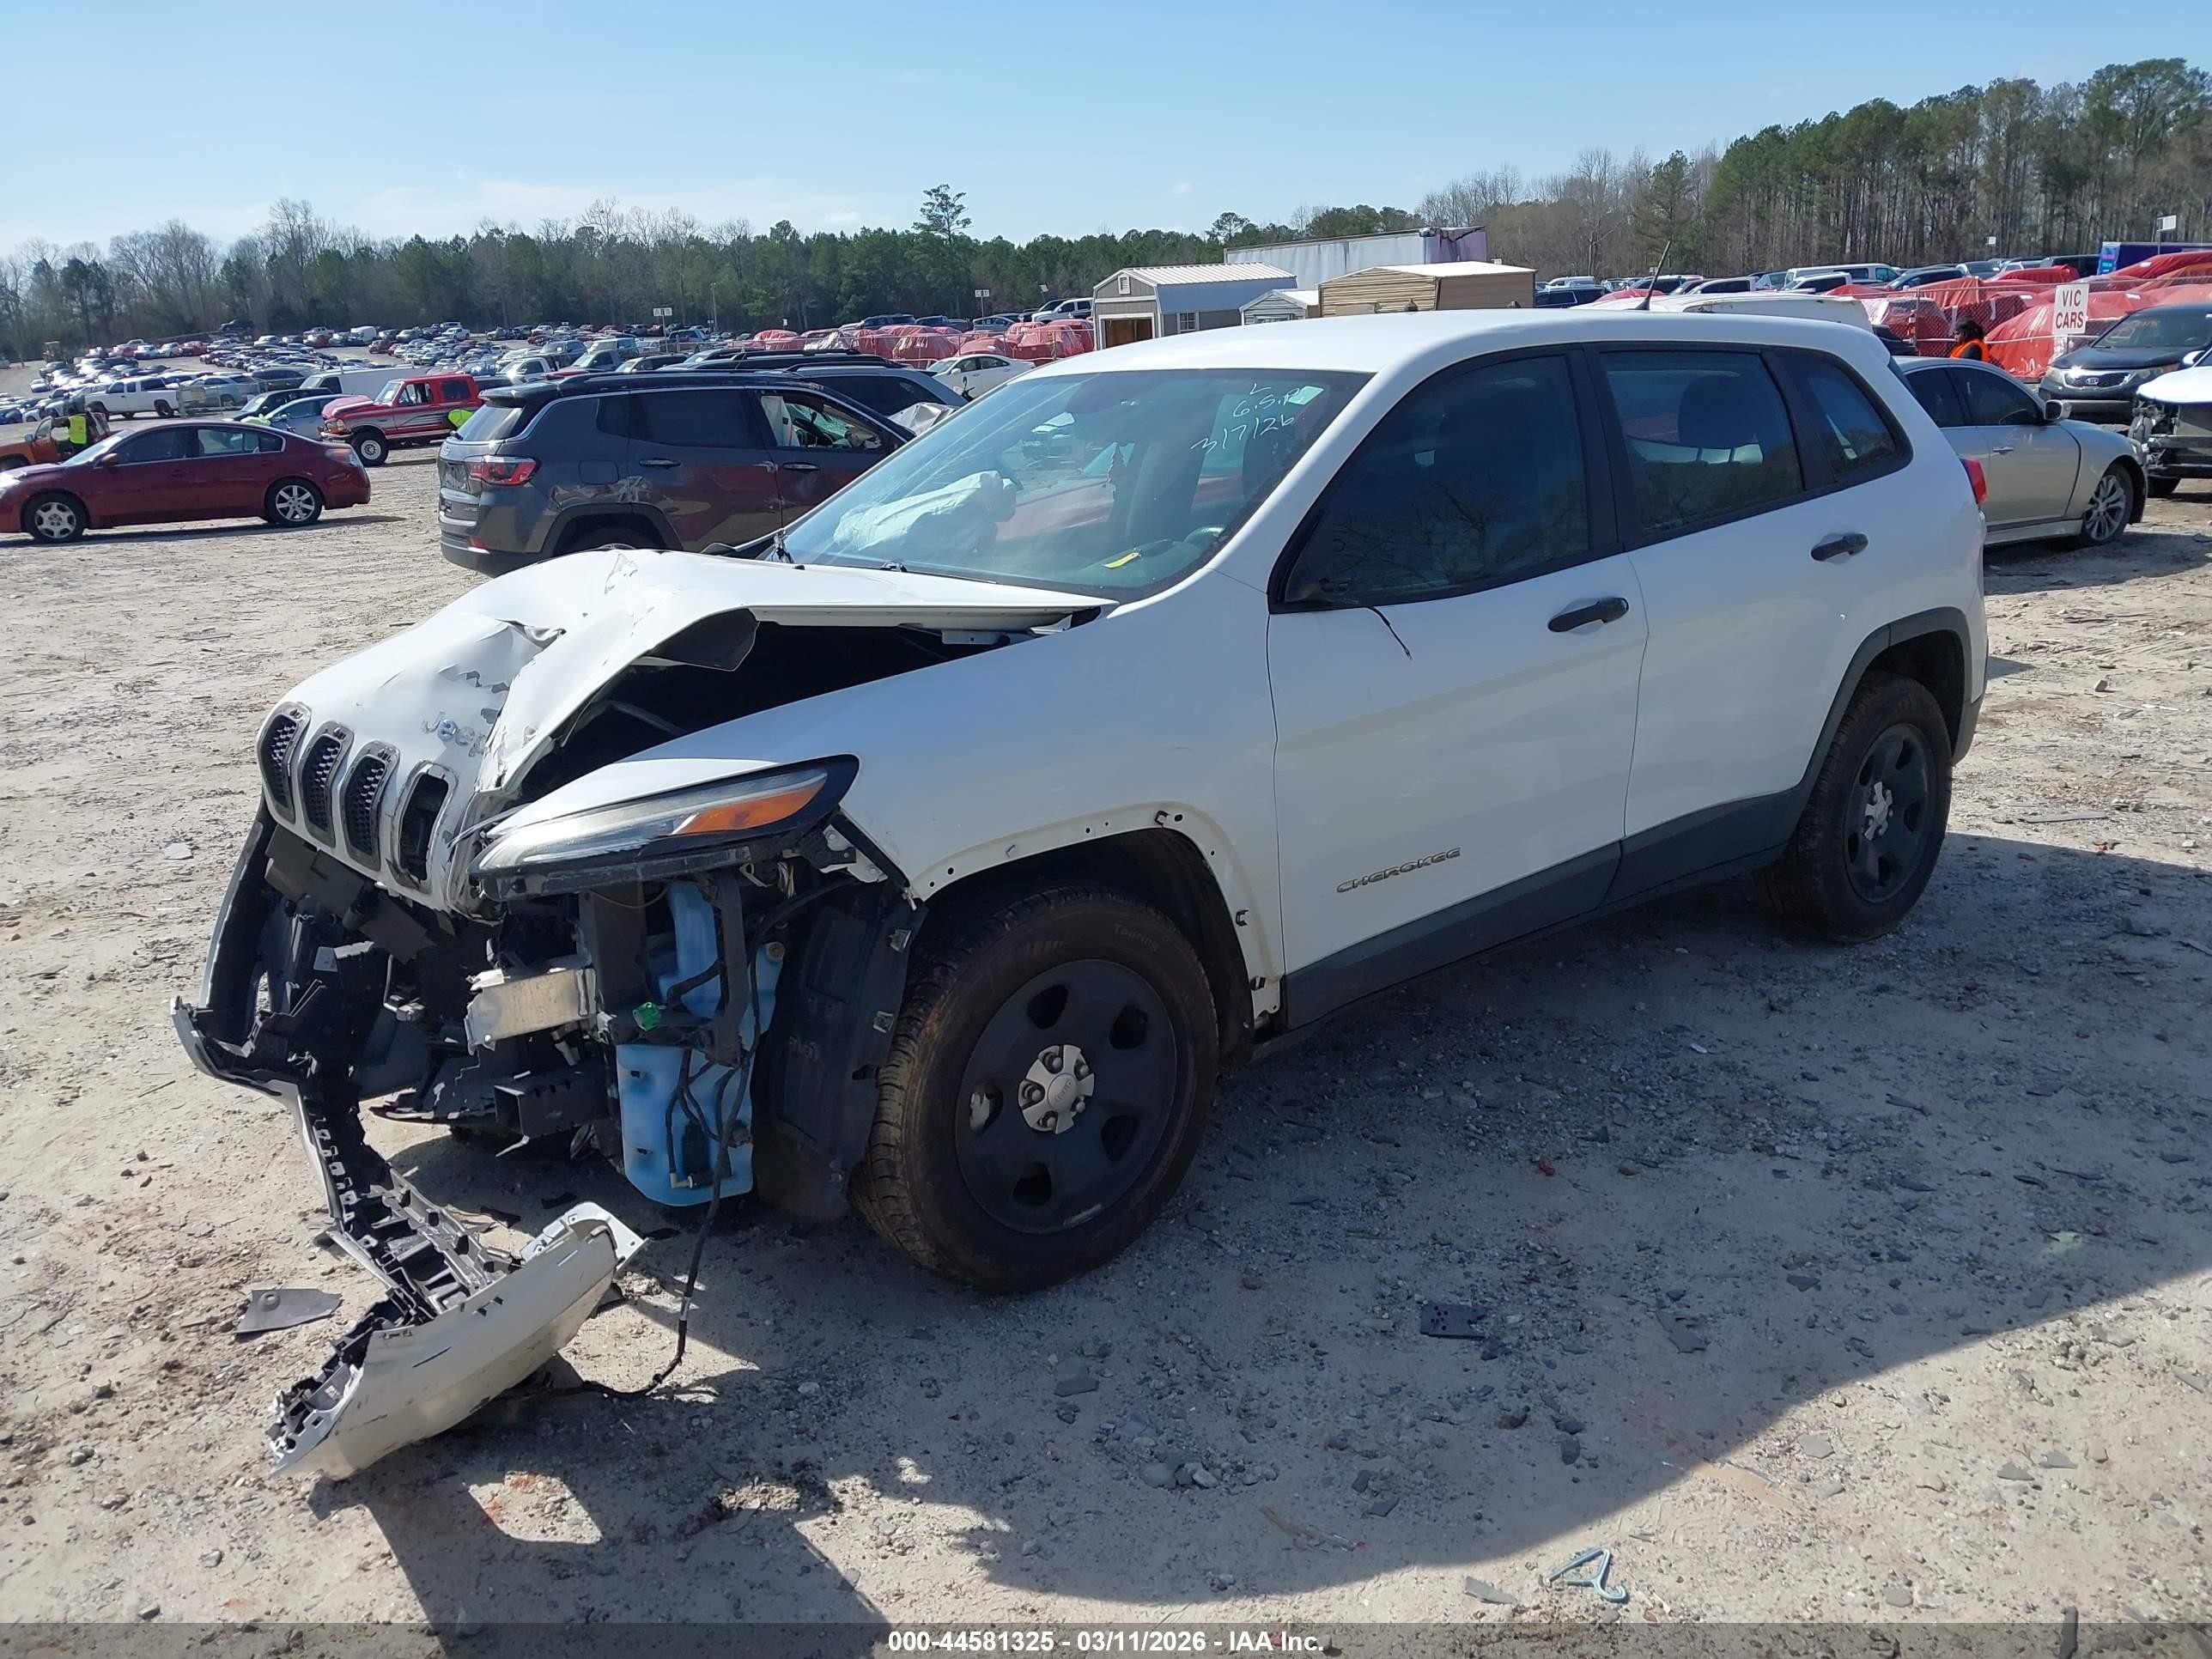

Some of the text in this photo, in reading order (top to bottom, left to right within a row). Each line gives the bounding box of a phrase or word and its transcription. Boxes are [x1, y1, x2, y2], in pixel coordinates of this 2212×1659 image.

[2063, 289, 2081, 307] VIC
[2056, 311, 2084, 329] CARS
[1336, 846, 1462, 893] CHEROKEE
